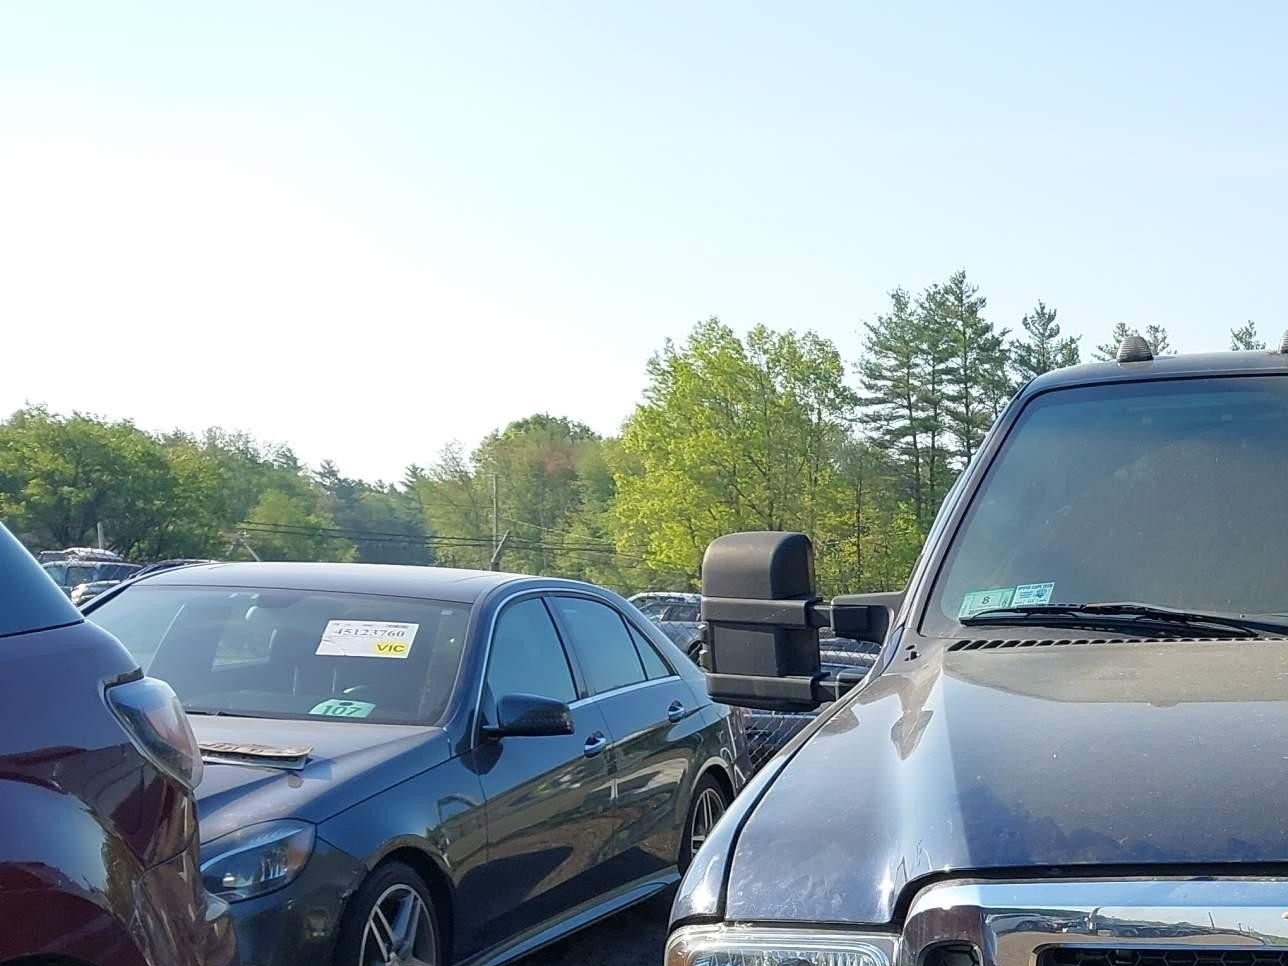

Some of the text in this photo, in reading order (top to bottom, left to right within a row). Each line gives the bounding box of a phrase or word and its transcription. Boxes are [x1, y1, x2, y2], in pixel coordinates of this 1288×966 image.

[334, 628, 405, 638] 45123760
[376, 643, 405, 653] VIC
[323, 705, 362, 716] 107
